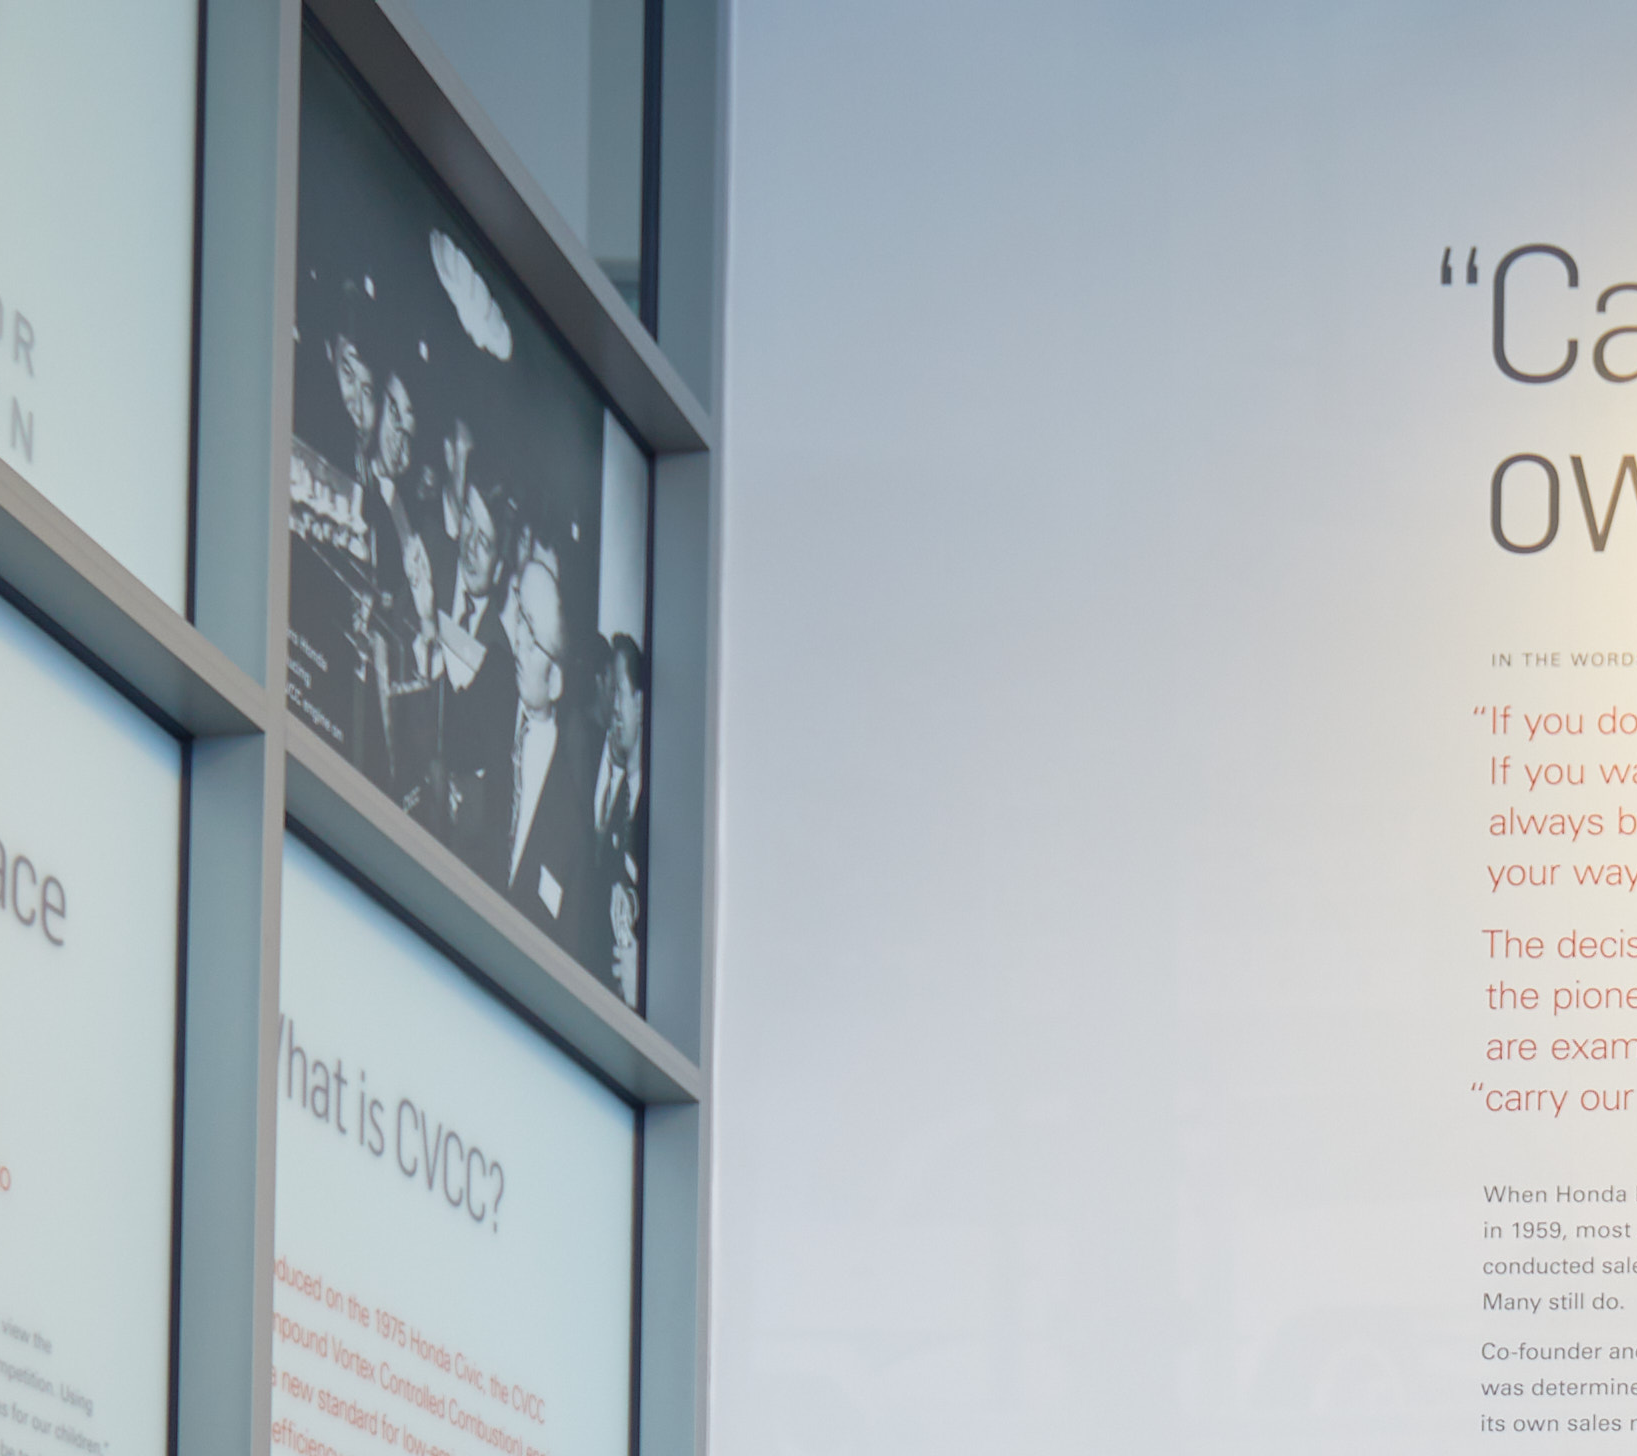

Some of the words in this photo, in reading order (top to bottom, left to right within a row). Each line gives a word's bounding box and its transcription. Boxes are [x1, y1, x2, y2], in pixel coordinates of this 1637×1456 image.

[1490, 652, 1512, 667] IN
[1524, 652, 1561, 667] THE
[1525, 714, 1583, 741] you
[1492, 756, 1510, 784] If
[1525, 764, 1584, 791] you
[359, 1071, 385, 1157] is
[396, 1097, 504, 1234] CVCC?
[1484, 1186, 1547, 1203] When
[1557, 1185, 1627, 1202] Honda
[1484, 1222, 1502, 1238] in
[1513, 1222, 1566, 1240] 1959,
[1576, 1224, 1630, 1238] most
[1481, 1342, 1602, 1360] Co-founder
